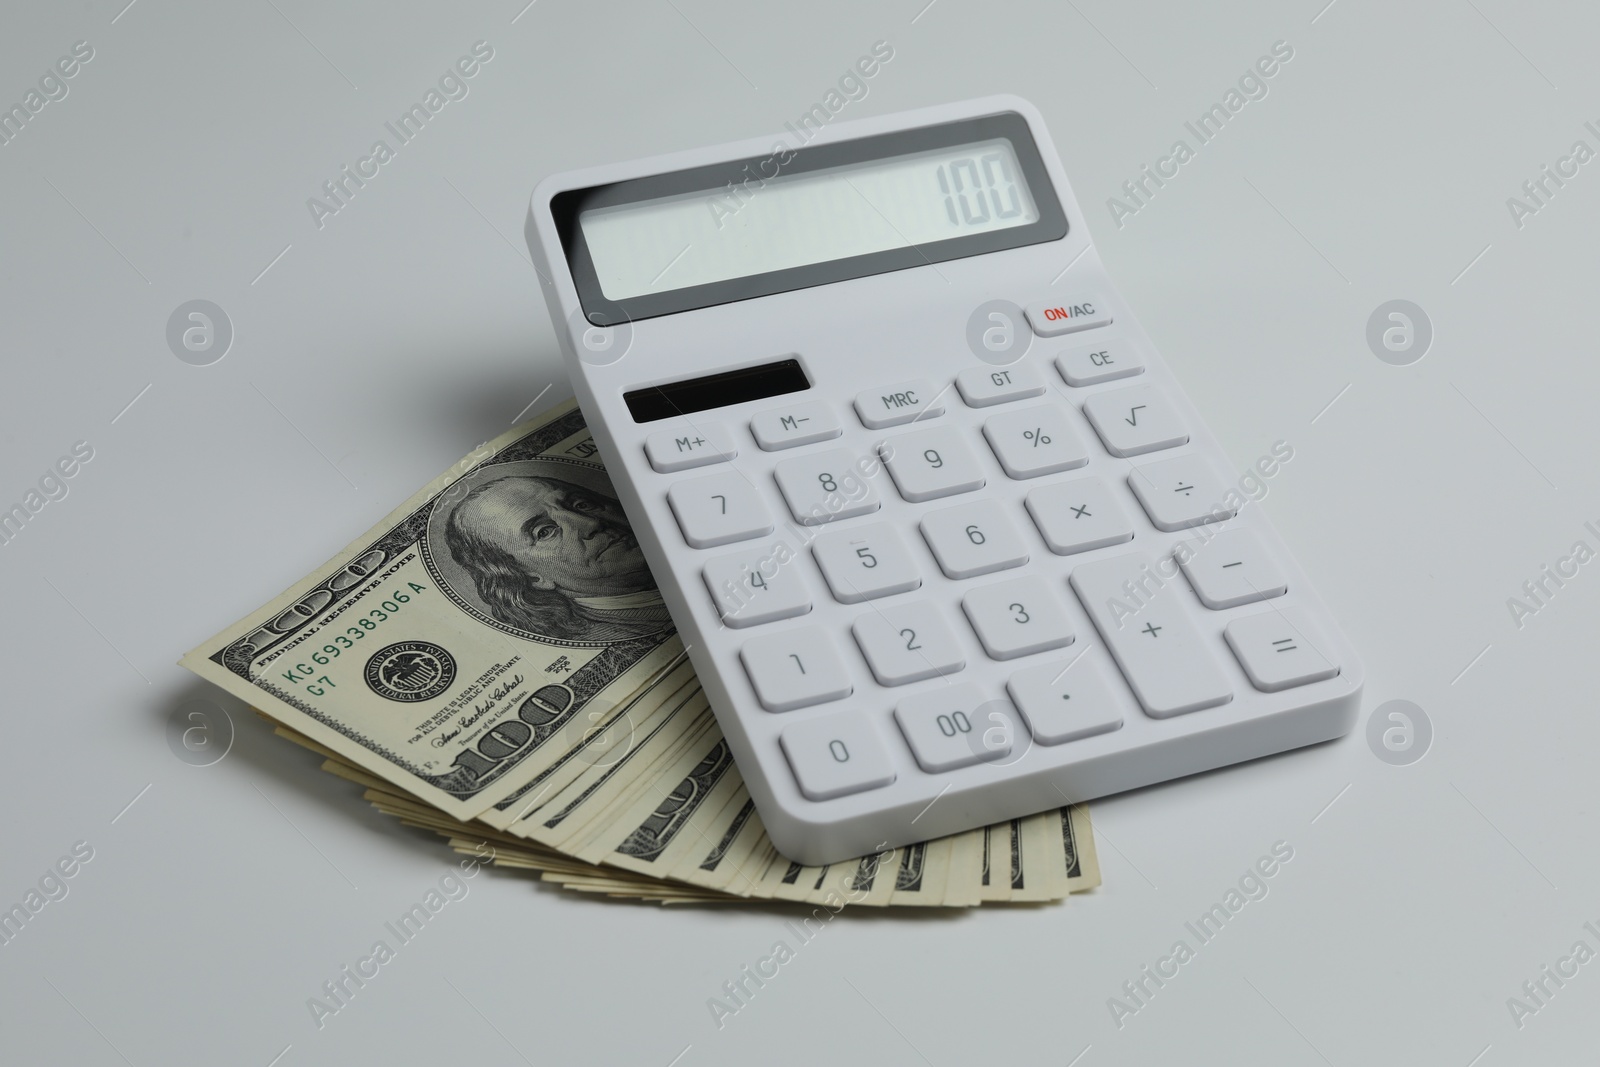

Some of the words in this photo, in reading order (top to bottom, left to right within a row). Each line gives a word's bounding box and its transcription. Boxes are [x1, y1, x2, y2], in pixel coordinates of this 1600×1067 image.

[1044, 302, 1096, 321] ON/AC
[1090, 350, 1115, 367] CE
[991, 370, 1012, 387] GT
[881, 391, 920, 411] MRC
[675, 436, 707, 454] M+
[923, 449, 944, 469] 9
[817, 472, 838, 493] 8
[710, 494, 727, 515] 7
[964, 524, 987, 546] 6
[855, 546, 878, 570] 5
[750, 570, 770, 593] 4
[240, 549, 388, 655] 100
[256, 626, 320, 667] FEDERAL
[318, 578, 382, 627] RESERVE
[381, 552, 417, 581] NOTE
[1008, 602, 1031, 625] 3
[282, 663, 315, 684] KG
[312, 590, 410, 665] 69338306
[407, 581, 427, 595] A
[899, 628, 923, 652] 2
[369, 654, 386, 681] UNITED
[384, 644, 417, 656] STATES
[425, 646, 452, 670] SYSTEM
[544, 655, 568, 673] SERIES
[788, 653, 807, 676] 1
[306, 676, 336, 697] G7
[377, 685, 416, 700] FEDERAL
[420, 672, 452, 699] RESERVE
[407, 732, 424, 745] FOR
[423, 723, 438, 736] ALL
[435, 708, 460, 727] DEBTS,
[458, 687, 484, 709] PUBLIC
[481, 676, 496, 689] AND
[495, 655, 521, 677] PRIVATE
[415, 718, 432, 732] THIS
[431, 705, 451, 722] NOTE
[449, 700, 458, 710] IS
[456, 684, 479, 702] LEGAL
[475, 663, 503, 684] TENDER
[482, 722, 490, 730] of
[487, 716, 497, 725] the
[494, 702, 514, 718] United
[935, 710, 973, 738] 00
[450, 682, 576, 781] 100
[828, 739, 852, 764] 0
